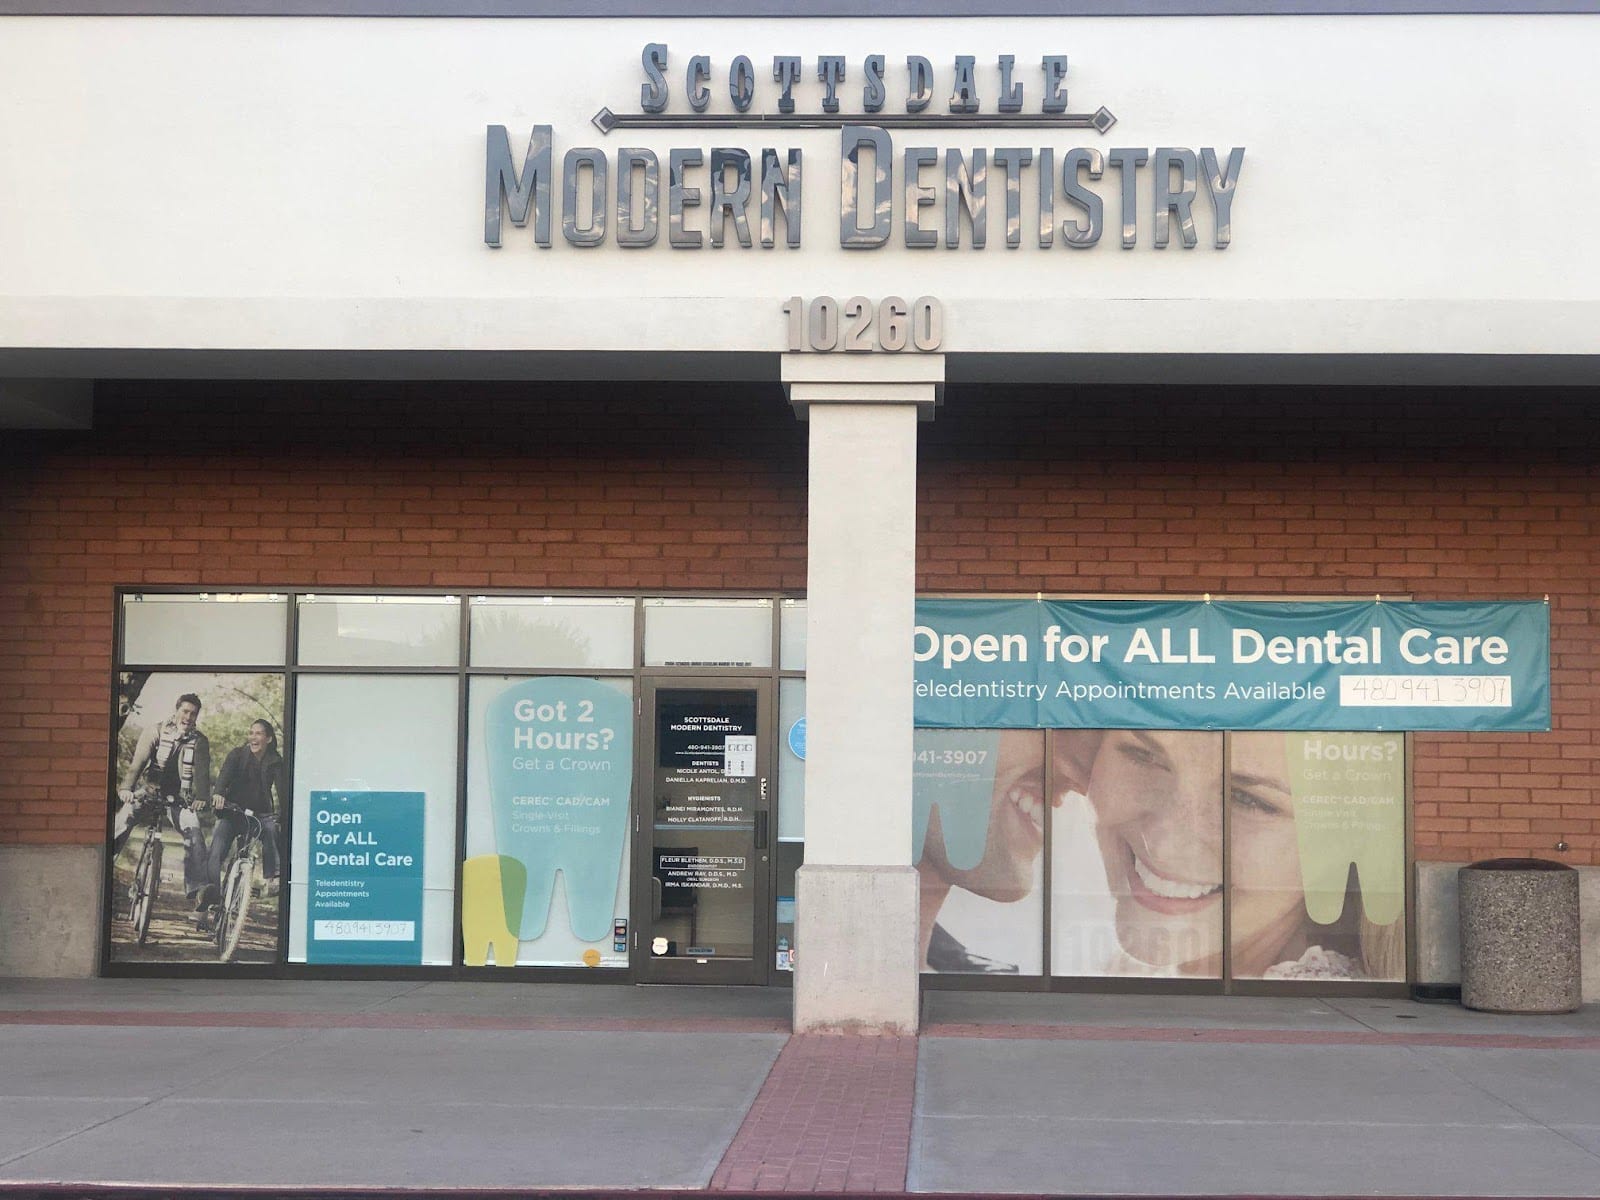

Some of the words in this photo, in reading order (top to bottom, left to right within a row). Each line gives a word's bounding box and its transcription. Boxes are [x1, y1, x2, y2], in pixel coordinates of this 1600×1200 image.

[641, 43, 1067, 114] SCOTTSDALE
[484, 124, 802, 248] MODERN
[840, 124, 1245, 248] DENTISTRY
[783, 295, 943, 352] 10260
[914, 625, 1028, 669] Open
[1043, 625, 1109, 663] for
[1123, 627, 1216, 664] ALL
[1232, 627, 1382, 665] Dental
[1399, 628, 1509, 665] Care
[913, 679, 1048, 701] eledentistry
[1055, 680, 1216, 702] Appointments
[1224, 681, 1327, 700] Available
[514, 699, 568, 722] Got
[577, 699, 595, 723] 2
[670, 724, 702, 732] MODERN
[684, 716, 730, 724] SCOTTSDALE
[514, 727, 615, 751] Hours?
[1303, 739, 1398, 761] Hours?
[512, 756, 541, 770] Get
[545, 759, 555, 770] a
[560, 757, 611, 771] Crown
[665, 776, 695, 784] DANIELLA
[556, 796, 610, 807] CAD/CAM
[316, 809, 362, 827] Open
[316, 830, 340, 845] for
[344, 831, 378, 845] ALL
[315, 851, 370, 866] Dental
[375, 852, 413, 866] Care
[315, 879, 366, 888] Teledentistry
[315, 890, 370, 899] Appointments
